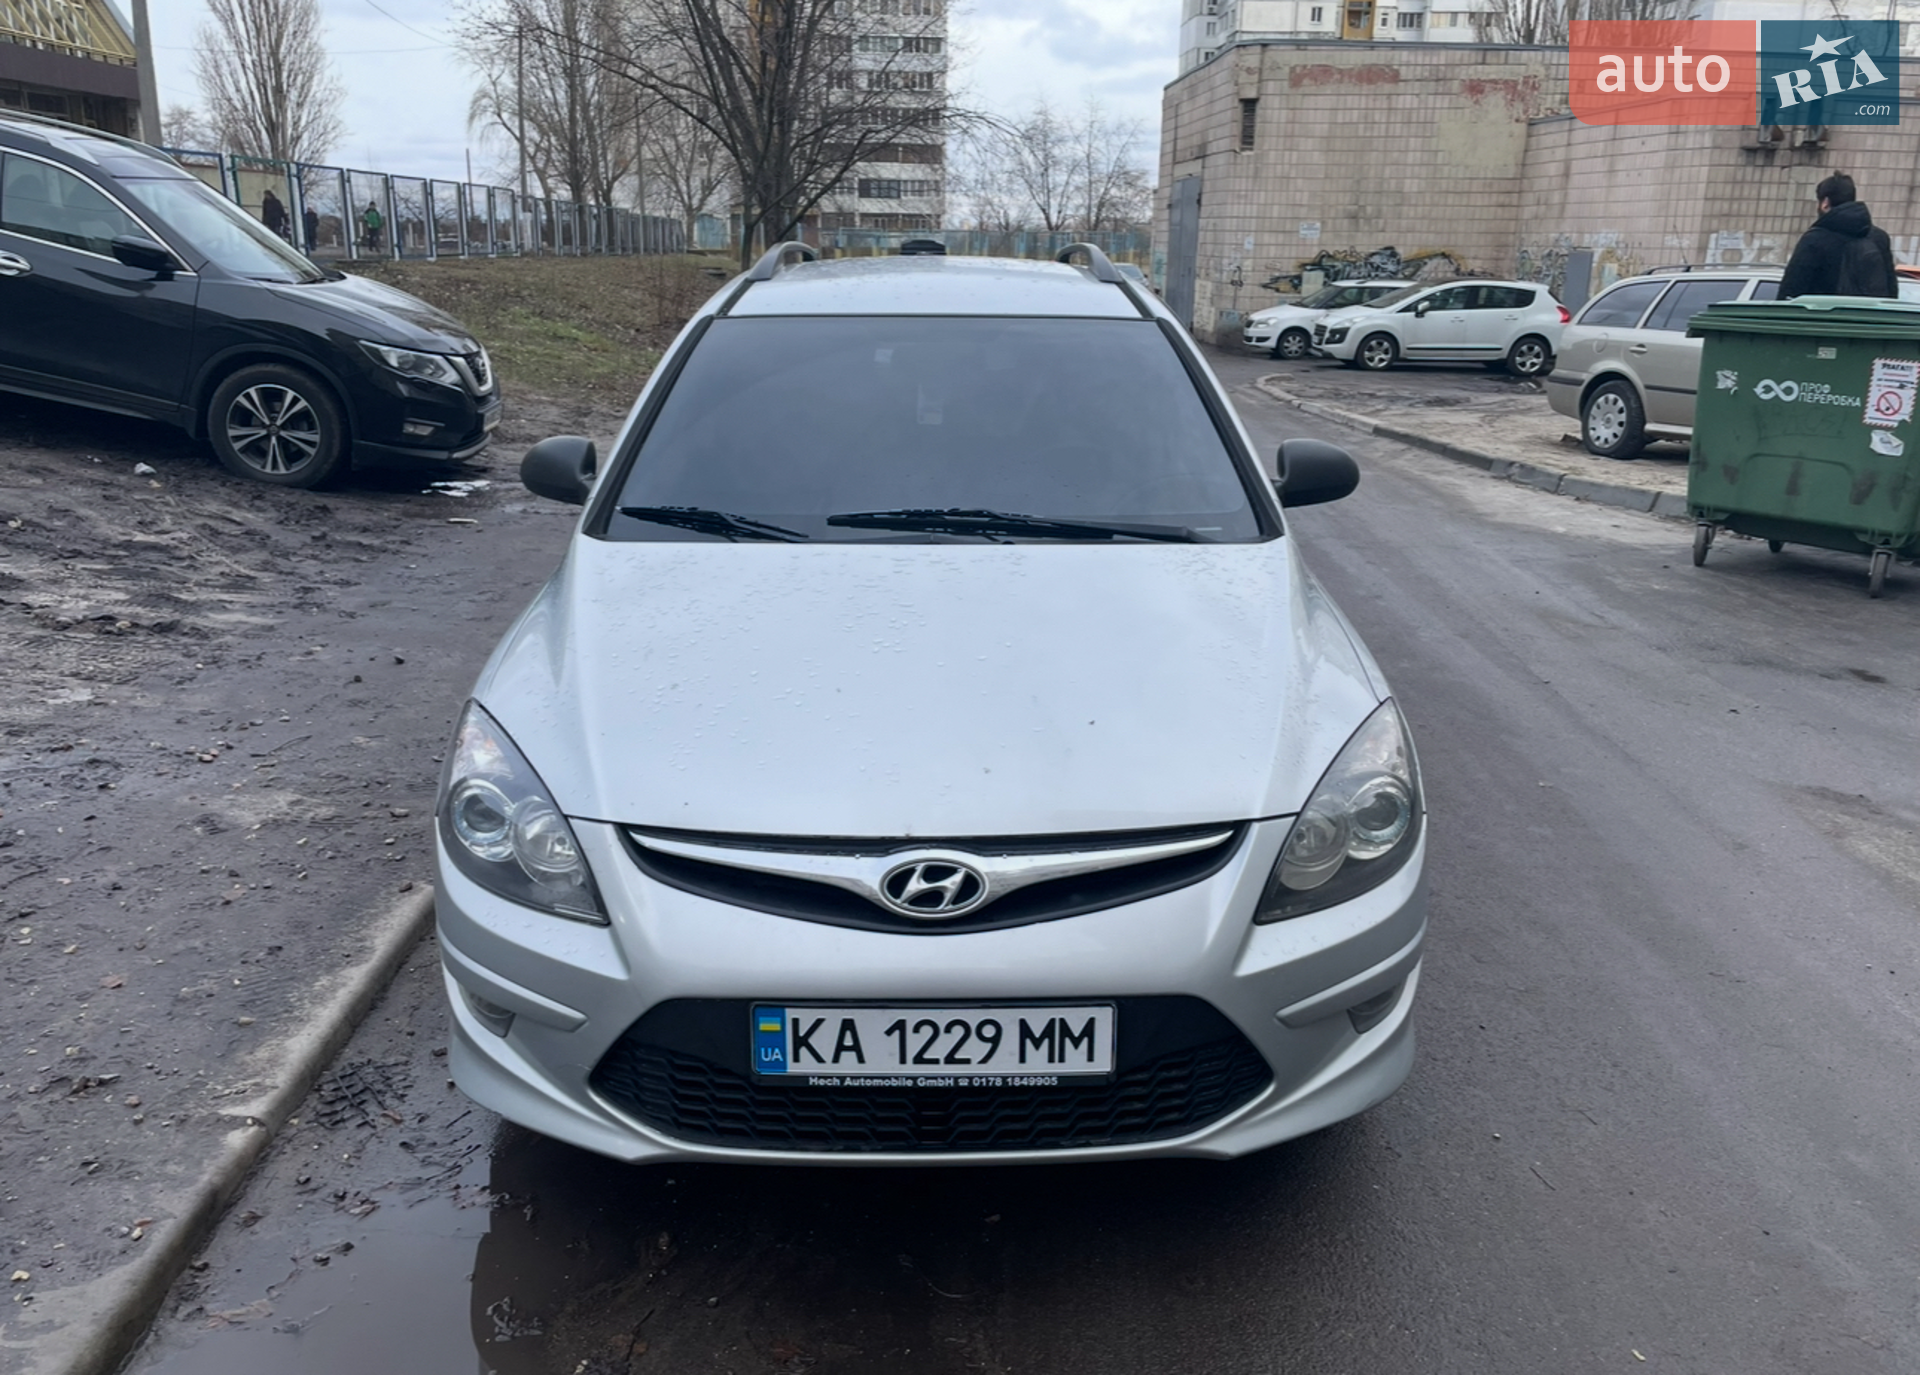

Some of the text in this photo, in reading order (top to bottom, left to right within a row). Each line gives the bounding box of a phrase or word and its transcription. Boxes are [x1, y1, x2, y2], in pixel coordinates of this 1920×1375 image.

[1798, 392, 1862, 407] ПЕРЕРОБКА
[791, 1016, 1096, 1065] KA 1229 MM
[760, 1047, 784, 1062] UA
[808, 1076, 840, 1086] Hech
[843, 1076, 914, 1087] Automobile
[916, 1076, 954, 1087] GmbH
[972, 1076, 1003, 1087] 0178
